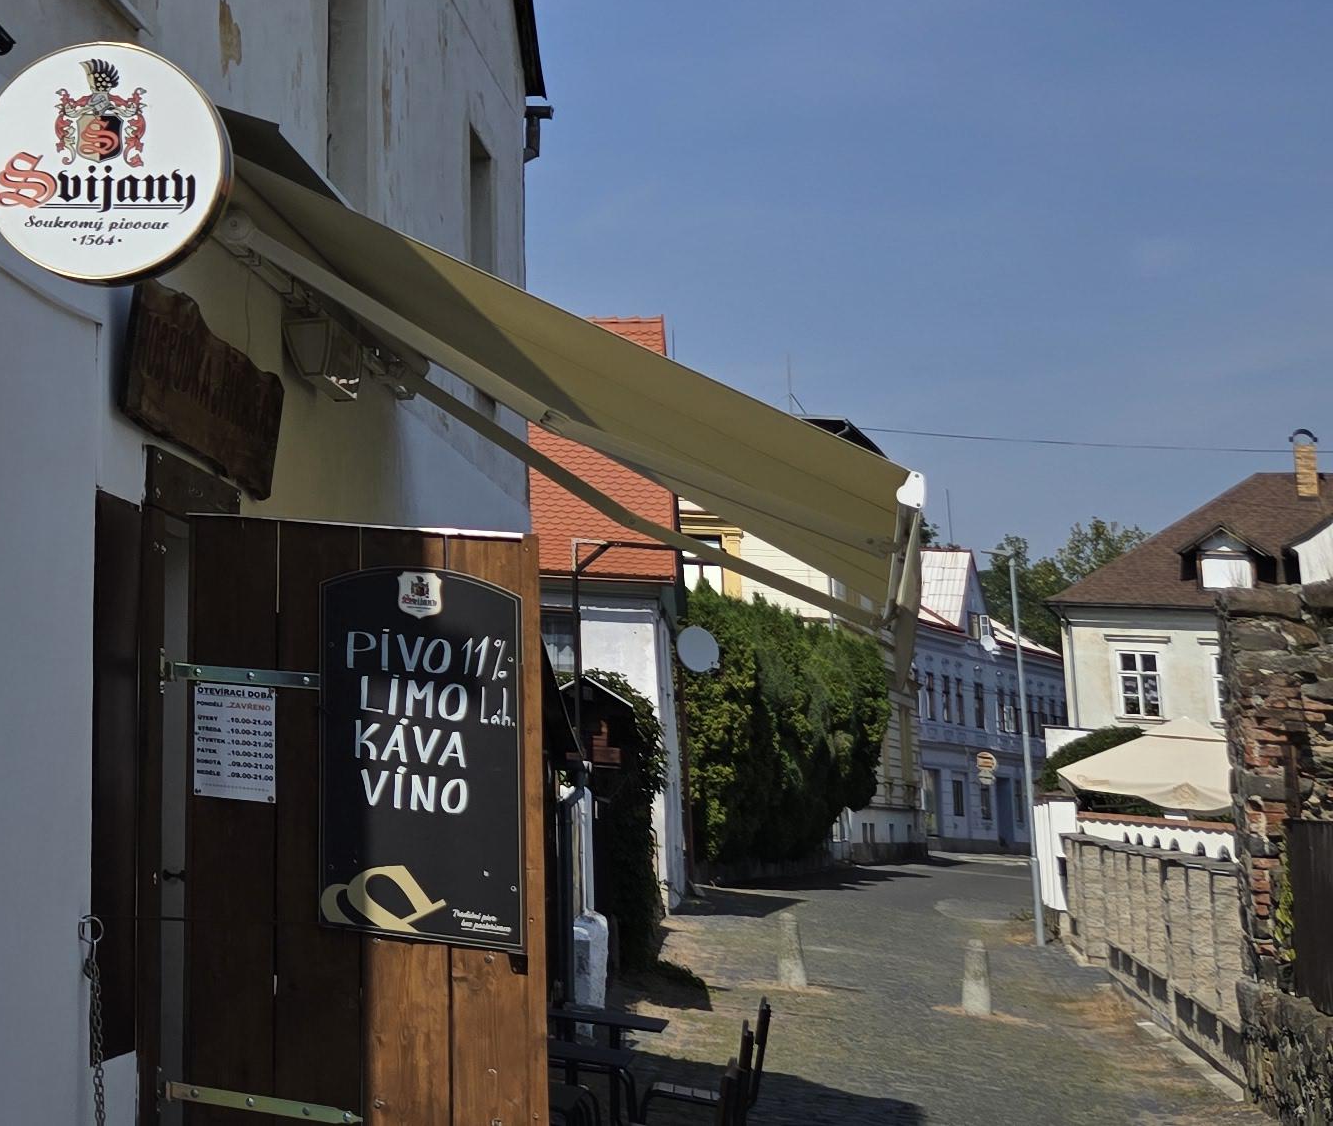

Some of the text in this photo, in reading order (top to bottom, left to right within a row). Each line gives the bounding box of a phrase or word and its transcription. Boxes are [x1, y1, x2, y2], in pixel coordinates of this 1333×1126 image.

[24, 215, 169, 231] Soukromý pivovar
[346, 629, 508, 681] PIVO 11%
[197, 687, 273, 699] OTEVÍRACÍ DOBA
[360, 674, 468, 721] LIMO
[355, 717, 466, 768] KÁVA
[361, 765, 469, 814] VÍNO
